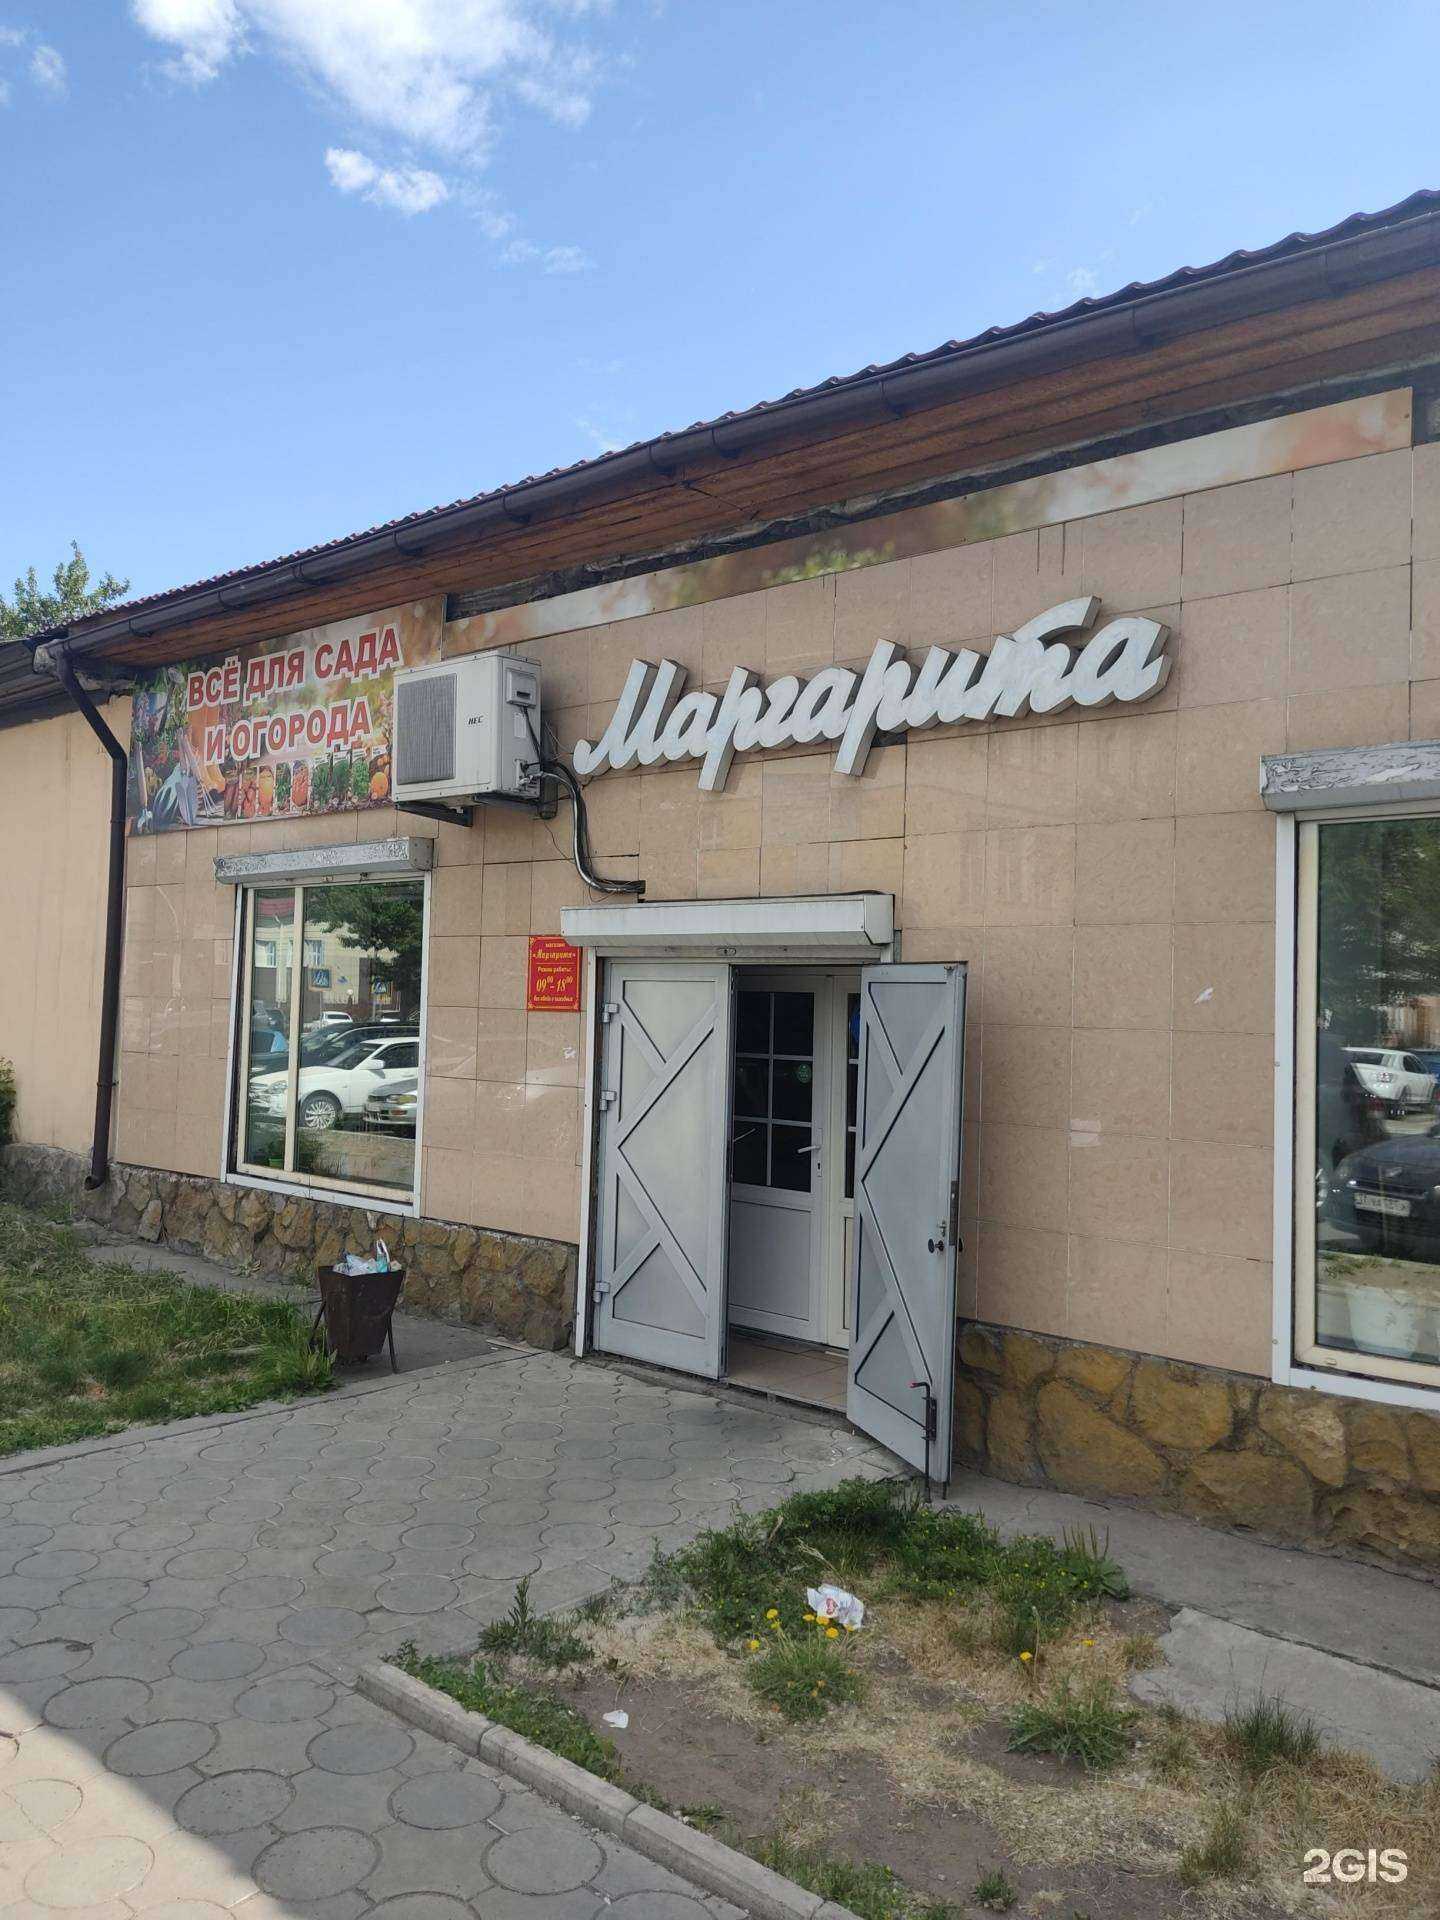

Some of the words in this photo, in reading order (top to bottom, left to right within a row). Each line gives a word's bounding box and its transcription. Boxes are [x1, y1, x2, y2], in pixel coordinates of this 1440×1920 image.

[188, 655, 240, 707] ВСЁ
[245, 650, 305, 702] ДЛЯ
[314, 627, 400, 680] САДА
[573, 595, 1172, 792] Маргарита
[206, 726, 226, 763] И
[232, 700, 371, 757] ОГОРОДА
